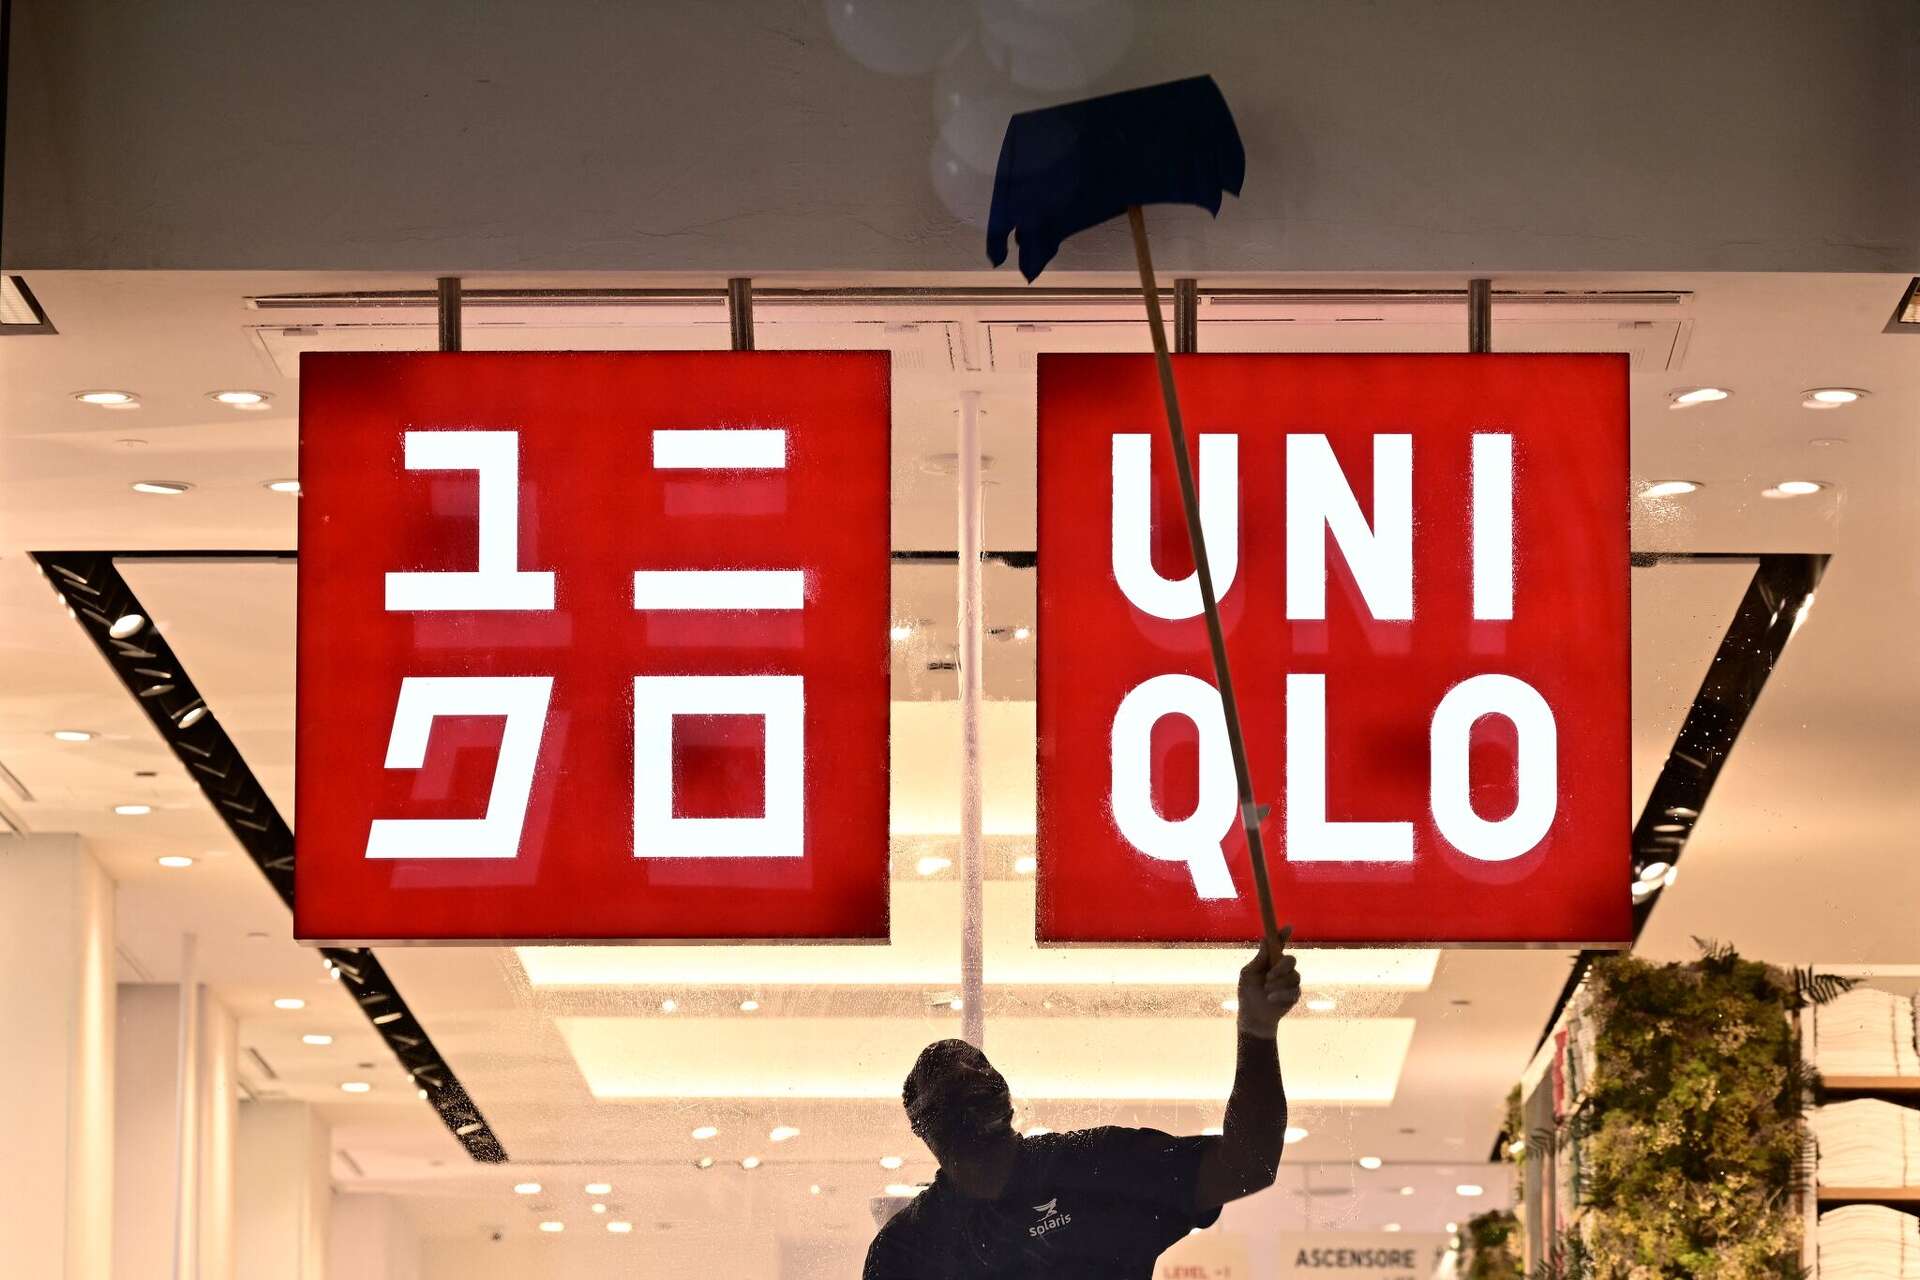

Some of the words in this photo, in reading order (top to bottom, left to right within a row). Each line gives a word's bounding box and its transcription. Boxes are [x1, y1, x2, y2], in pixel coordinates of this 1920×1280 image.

[385, 429, 805, 611] ユニ
[1111, 433, 1515, 620] UNI
[365, 675, 805, 858] クロ
[1110, 673, 1558, 900] QLO
[1028, 1213, 1072, 1237] solaris
[1295, 1248, 1416, 1268] ASCENSORE
